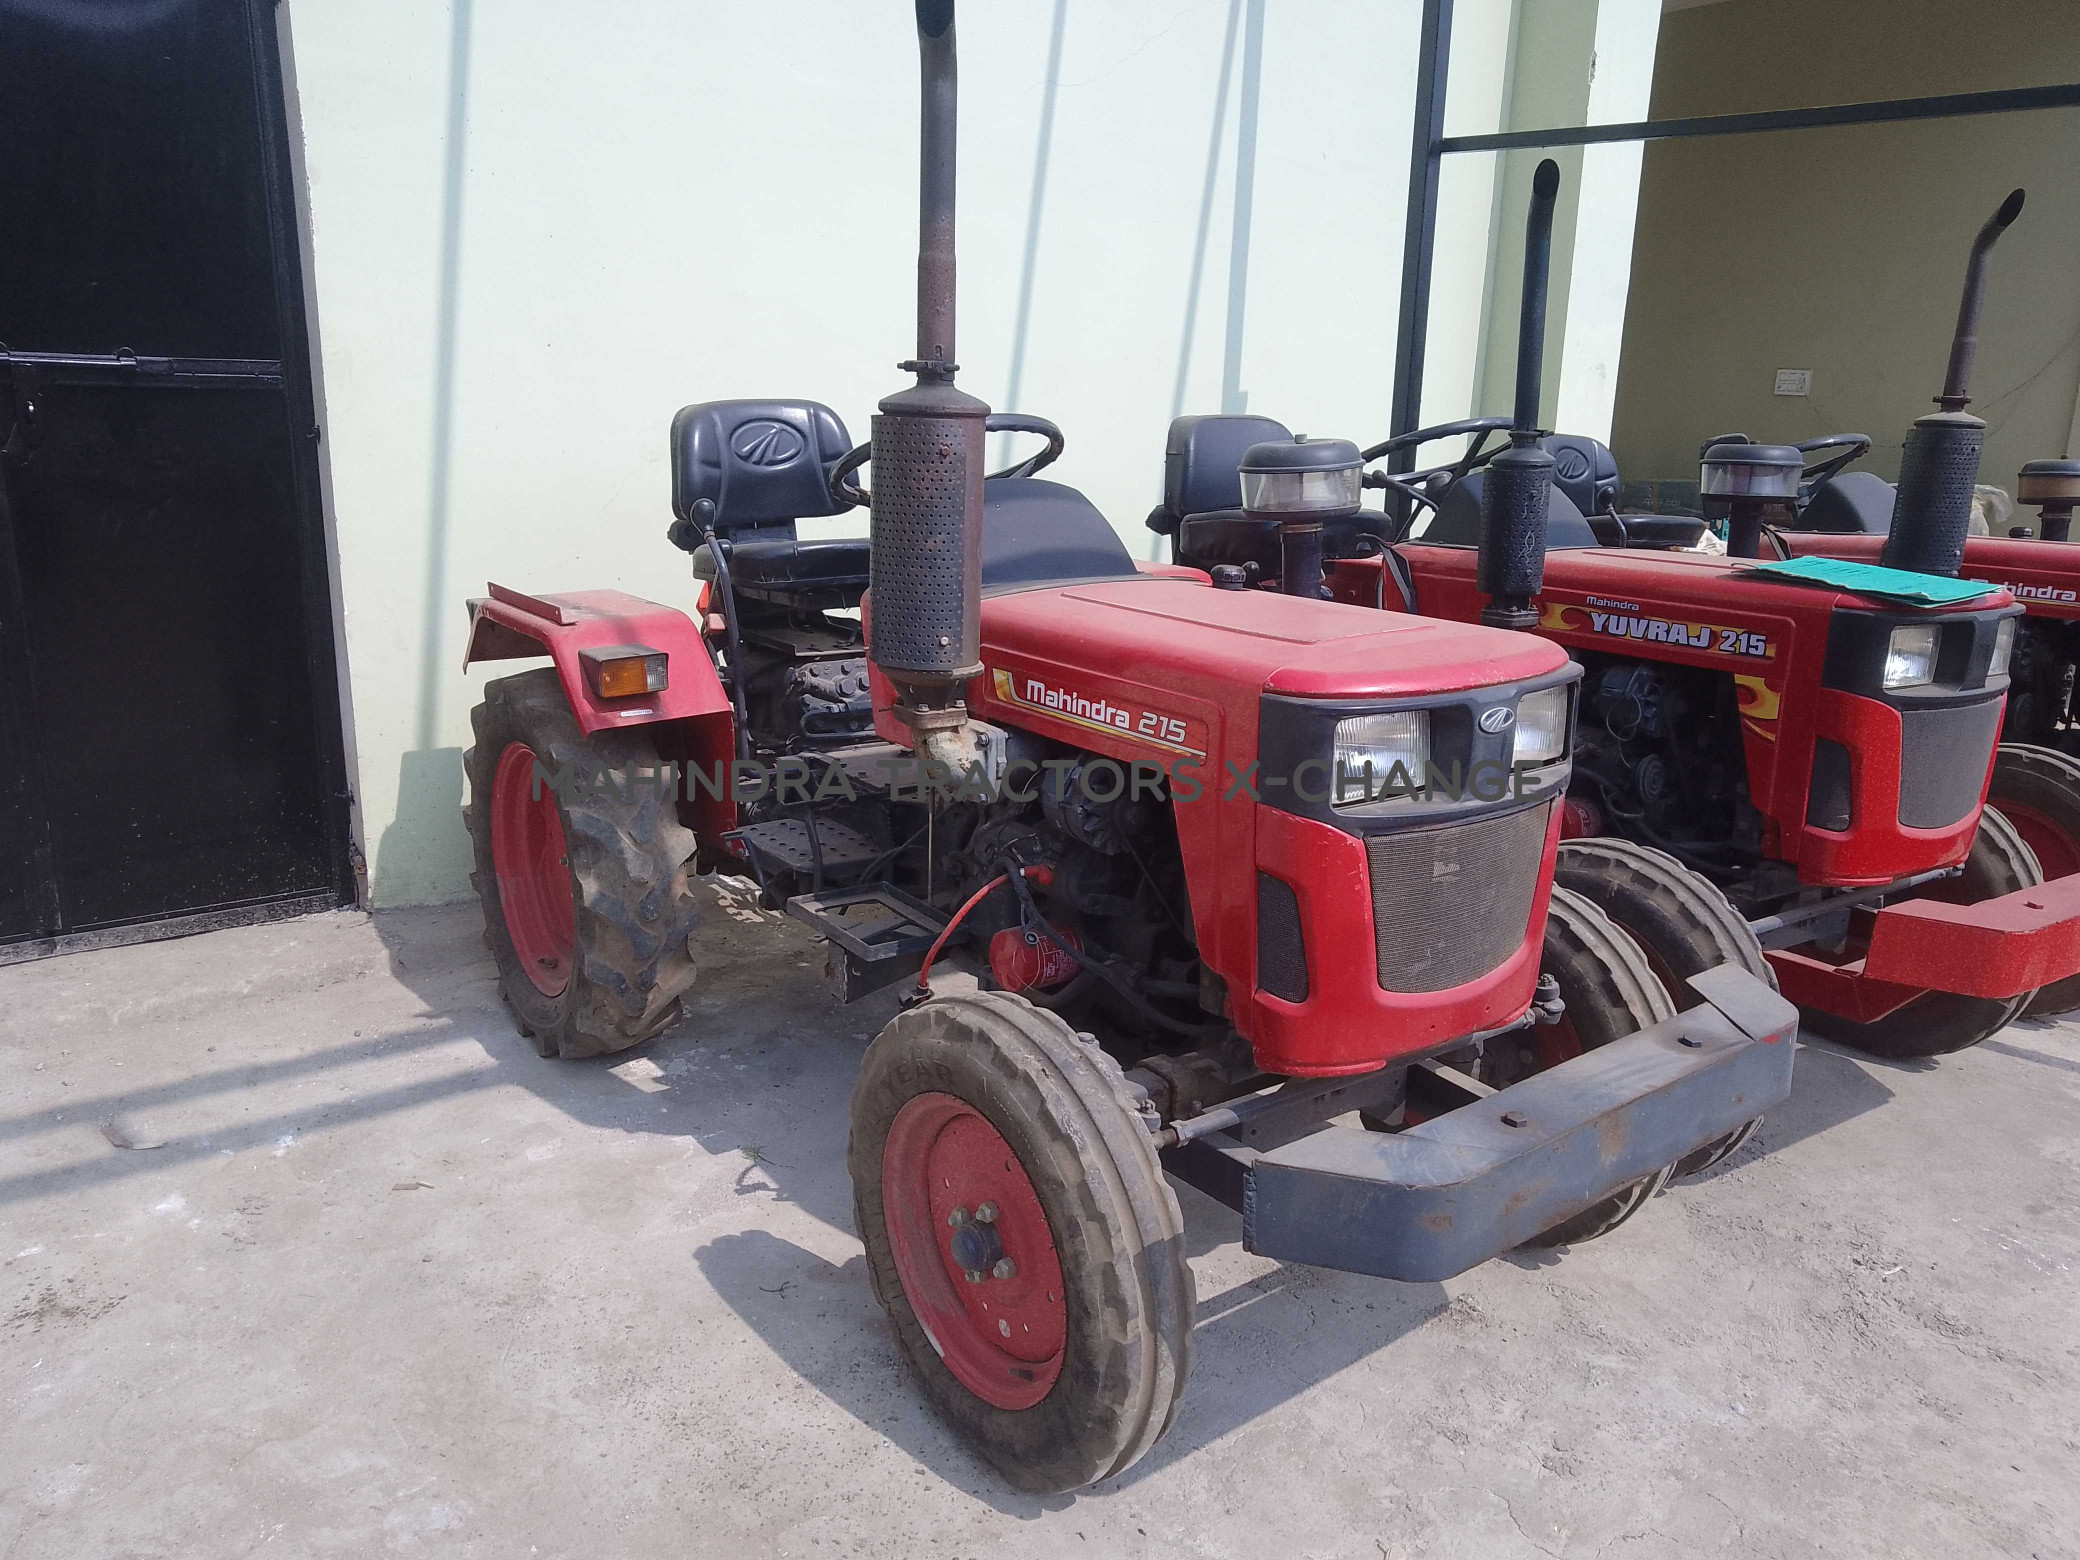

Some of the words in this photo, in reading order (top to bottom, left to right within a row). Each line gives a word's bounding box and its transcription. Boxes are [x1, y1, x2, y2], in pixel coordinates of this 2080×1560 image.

[1586, 595, 1639, 612] Mahindra
[1970, 578, 2077, 601] hindra
[1590, 611, 1711, 648] YUVRAJ
[1718, 629, 1767, 656] 215
[1026, 679, 1130, 729] Mahindra
[1137, 711, 1188, 743] 215
